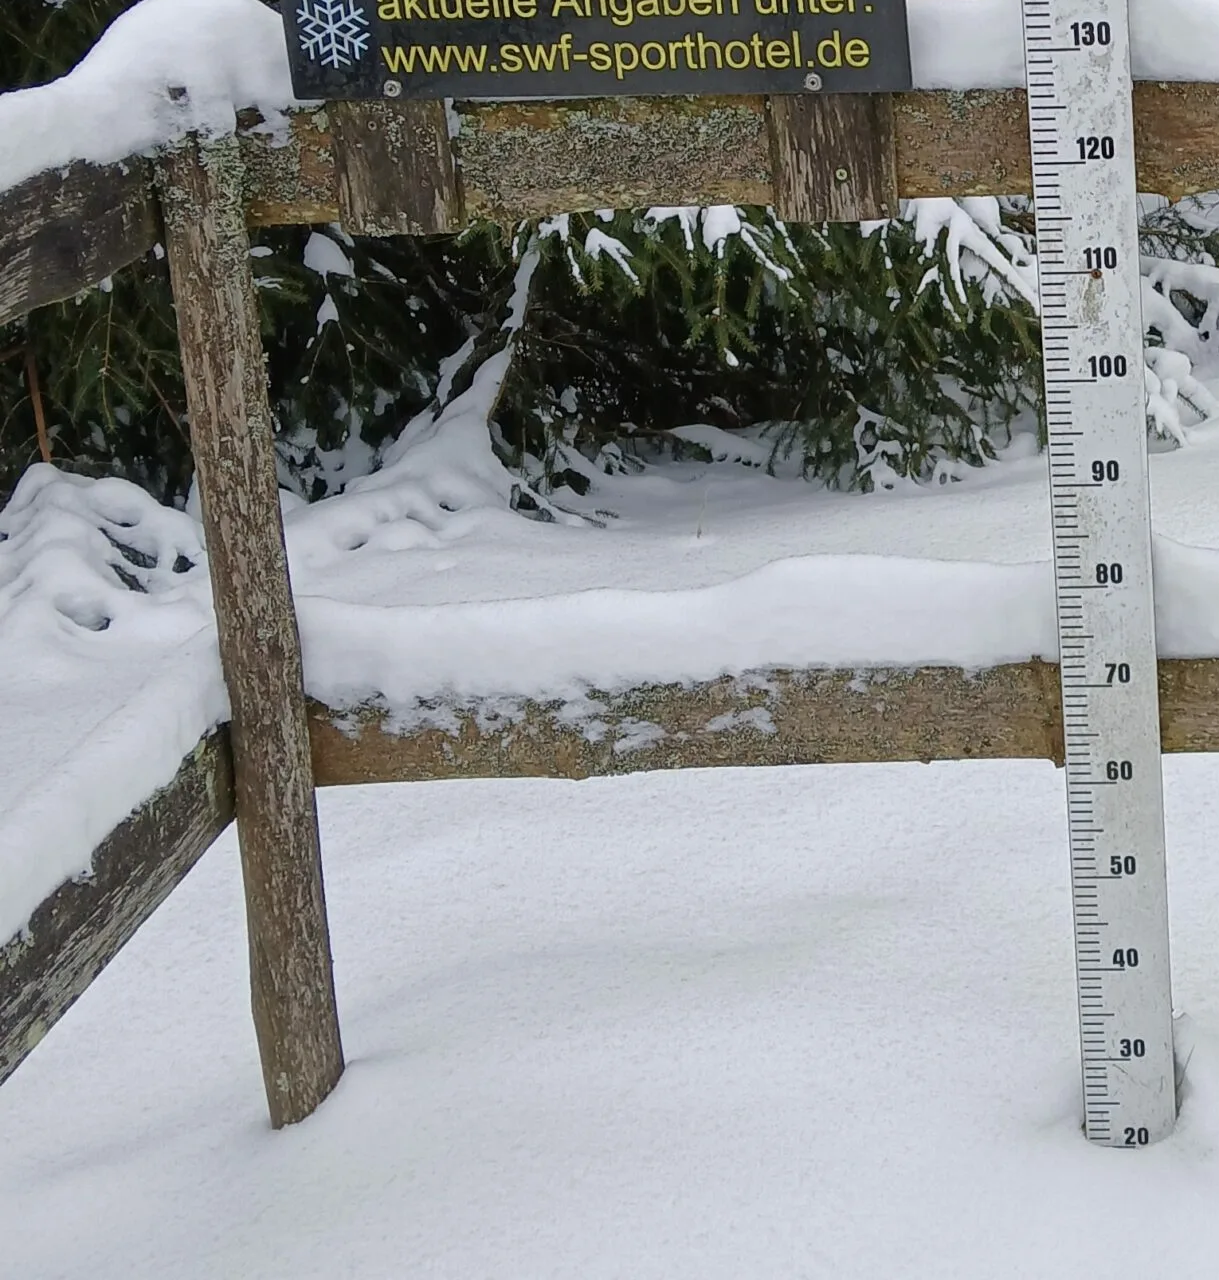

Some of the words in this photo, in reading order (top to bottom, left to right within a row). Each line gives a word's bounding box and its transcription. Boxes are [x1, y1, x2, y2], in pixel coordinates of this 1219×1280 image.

[1070, 21, 1111, 46] 130
[381, 29, 870, 79] www.swf-sporthotel.de
[1076, 136, 1114, 160] 120
[1083, 247, 1117, 269] 110
[1088, 355, 1127, 378] 100
[1091, 460, 1119, 482] 90
[1095, 563, 1123, 584] 80
[1105, 663, 1131, 684] 70
[1106, 760, 1133, 781] 60
[1110, 855, 1136, 876] 50
[1112, 948, 1138, 968] 40
[1119, 1039, 1145, 1057] 30
[1124, 1127, 1149, 1145] 20
